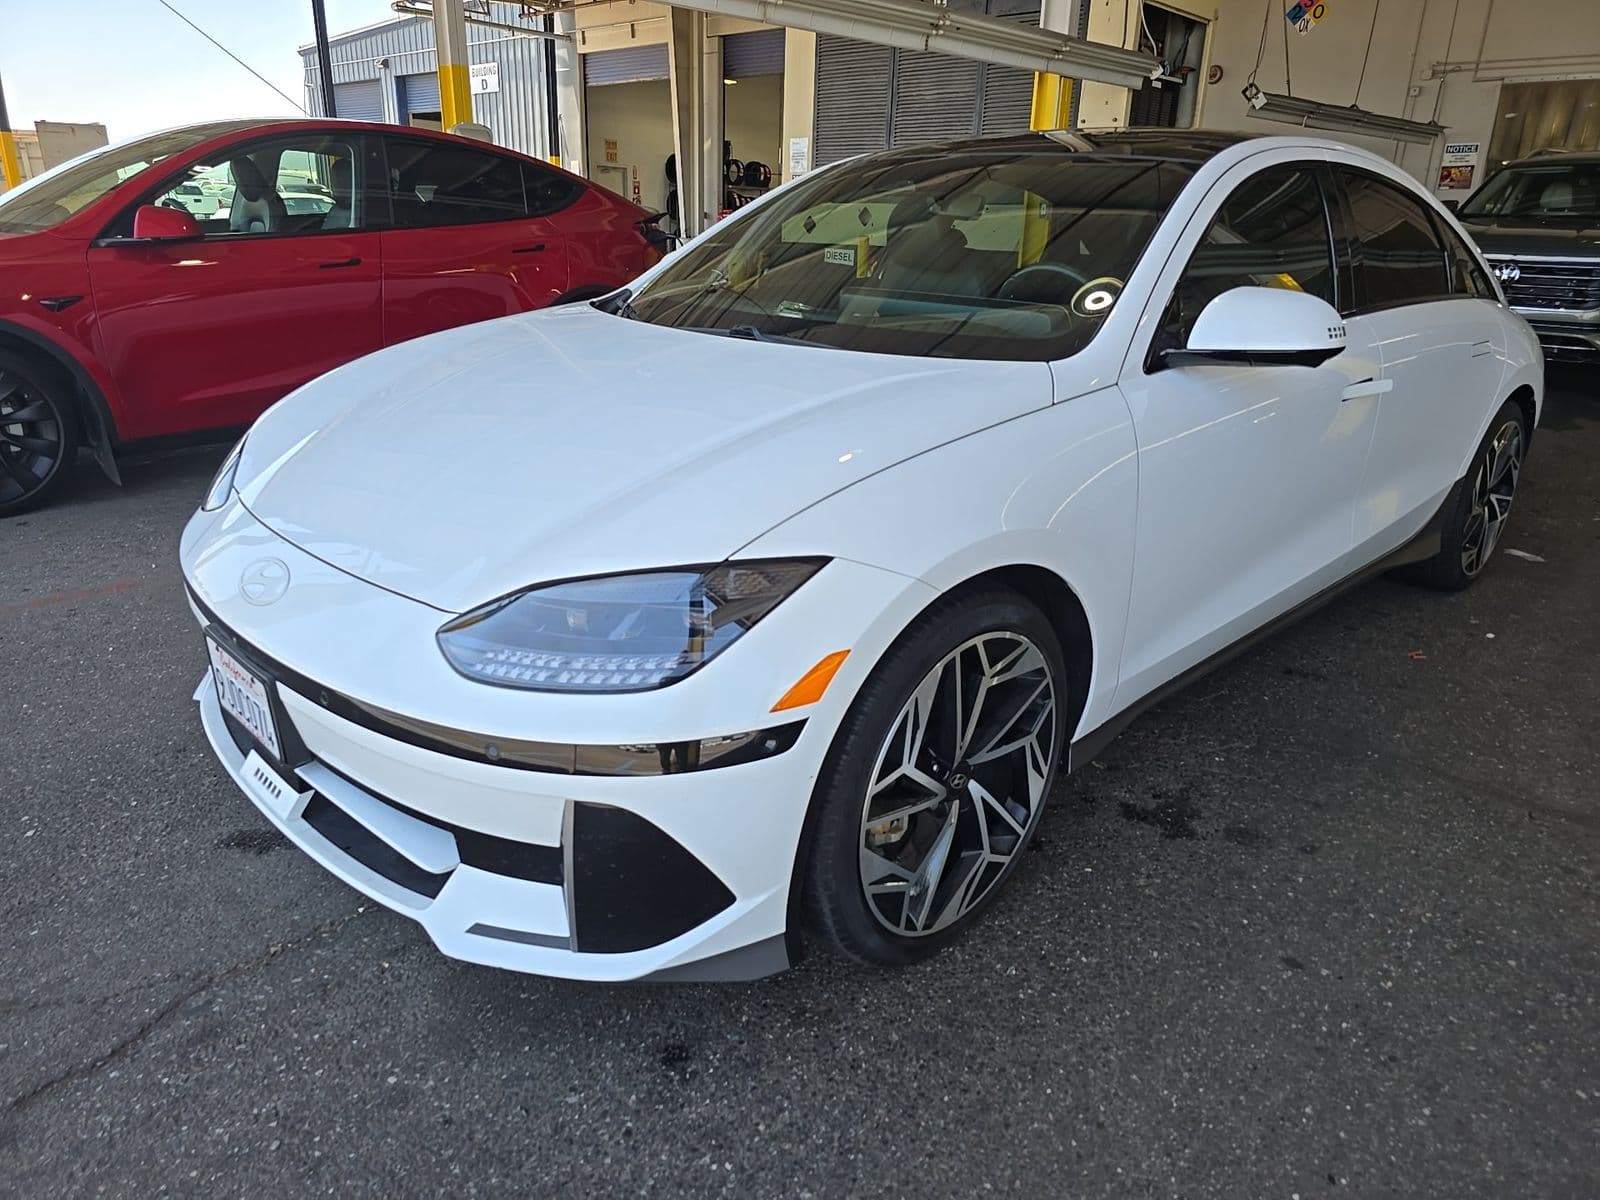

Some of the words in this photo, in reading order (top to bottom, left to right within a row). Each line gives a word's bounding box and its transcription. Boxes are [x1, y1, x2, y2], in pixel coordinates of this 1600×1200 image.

[471, 65, 497, 78] BUILDING
[481, 79, 488, 91] D
[1447, 145, 1478, 153] NOTICE
[825, 250, 853, 263] DIESEL
